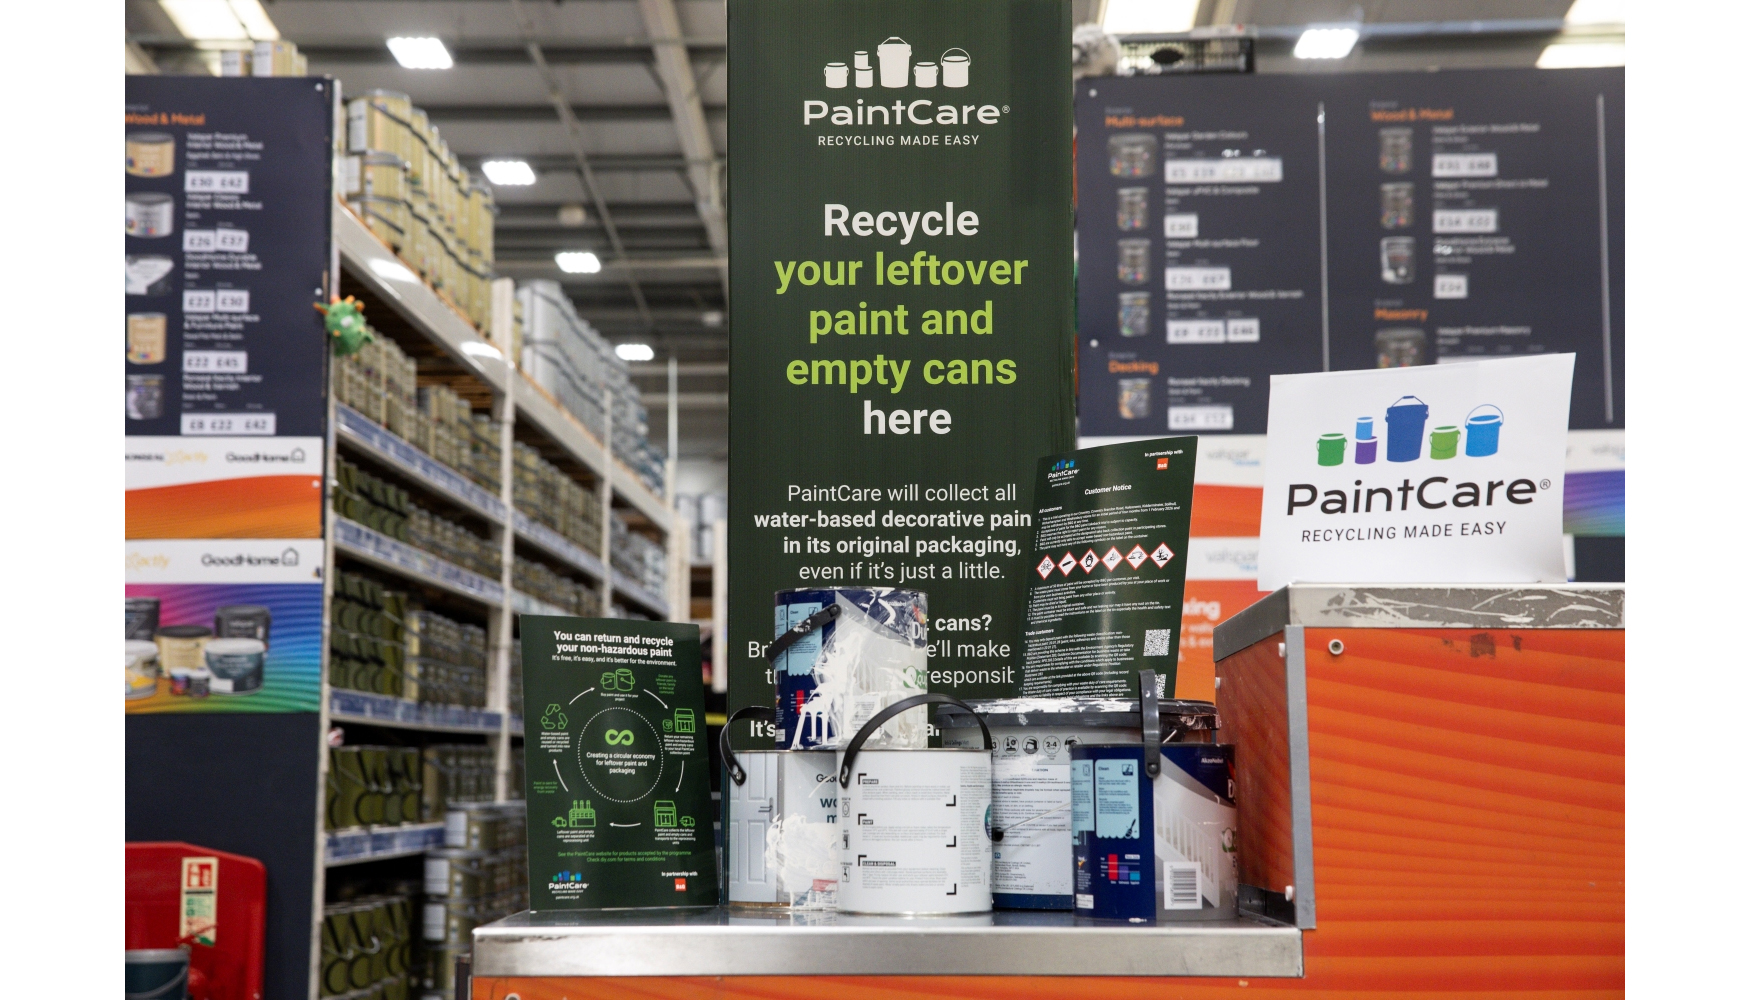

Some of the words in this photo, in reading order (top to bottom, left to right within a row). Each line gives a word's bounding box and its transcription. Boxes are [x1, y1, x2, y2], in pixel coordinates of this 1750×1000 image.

[819, 136, 894, 145] RECYCLING
[901, 136, 938, 145] MADE
[945, 135, 979, 145] EASY
[825, 202, 979, 245] Recycle
[774, 261, 862, 294] your
[876, 251, 1028, 285] leftover
[810, 302, 908, 343] paint
[922, 301, 992, 335] and
[787, 355, 911, 393] empty
[924, 359, 1016, 384] cans
[864, 400, 951, 434] here
[1148, 450, 1173, 458] partnership
[789, 485, 881, 501] PaintCare
[888, 484, 918, 501] will
[926, 484, 989, 501] collect
[996, 484, 1015, 501] all
[1084, 485, 1112, 495] Customer
[754, 510, 875, 527] water-based
[882, 510, 984, 527] decorative
[990, 510, 1032, 531] pain
[1301, 526, 1397, 543] RECYCLING
[1404, 524, 1453, 539] MADE
[1461, 521, 1507, 537] EASY
[784, 537, 800, 553] in
[807, 536, 830, 553] its
[837, 536, 909, 557] original
[916, 536, 1020, 557] packaging,
[800, 567, 843, 579] even
[851, 562, 863, 579] if
[899, 563, 935, 583] just
[942, 566, 952, 579] a
[960, 562, 1004, 578] little.
[935, 614, 992, 631] cans?
[553, 630, 573, 641] You
[574, 633, 592, 642] can
[593, 633, 621, 643] return
[623, 635, 640, 645] and
[641, 636, 674, 648] recycle
[958, 640, 1010, 657] make
[556, 644, 578, 654] your
[580, 644, 648, 656] non-hazardous
[650, 648, 672, 658] paint
[609, 767, 636, 775] packaging
